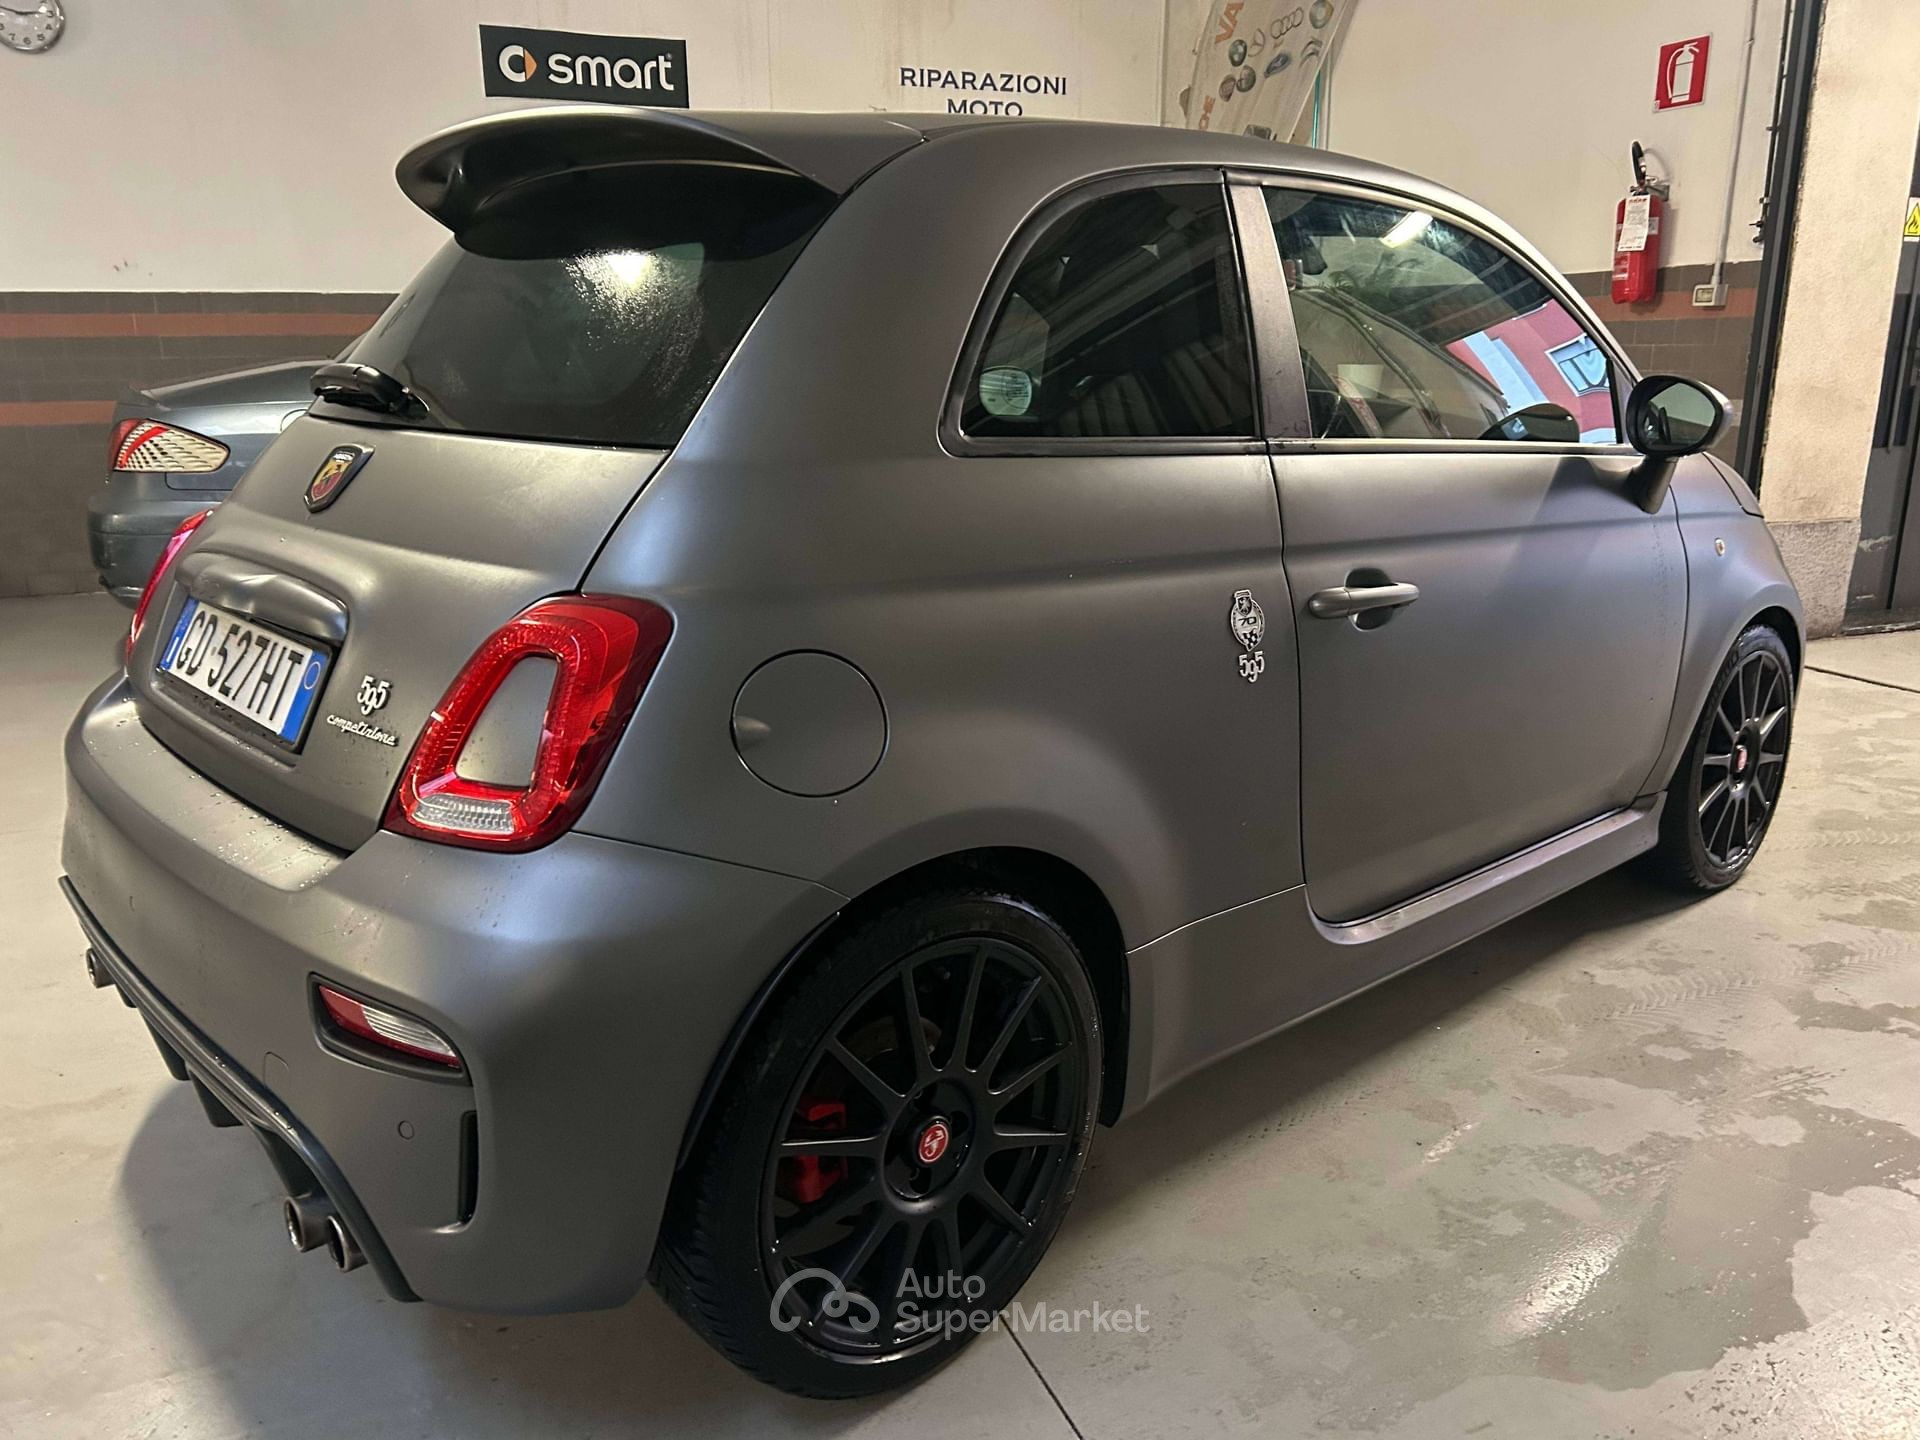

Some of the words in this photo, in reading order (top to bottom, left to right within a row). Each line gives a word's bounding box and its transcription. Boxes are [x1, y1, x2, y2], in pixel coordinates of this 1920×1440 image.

[548, 53, 675, 91] smart
[899, 67, 1067, 96] RIPARAZIONI
[947, 98, 1023, 117] MOTO
[1238, 650, 1265, 683] 595
[357, 675, 390, 715] 595
[326, 714, 396, 746] competizione
